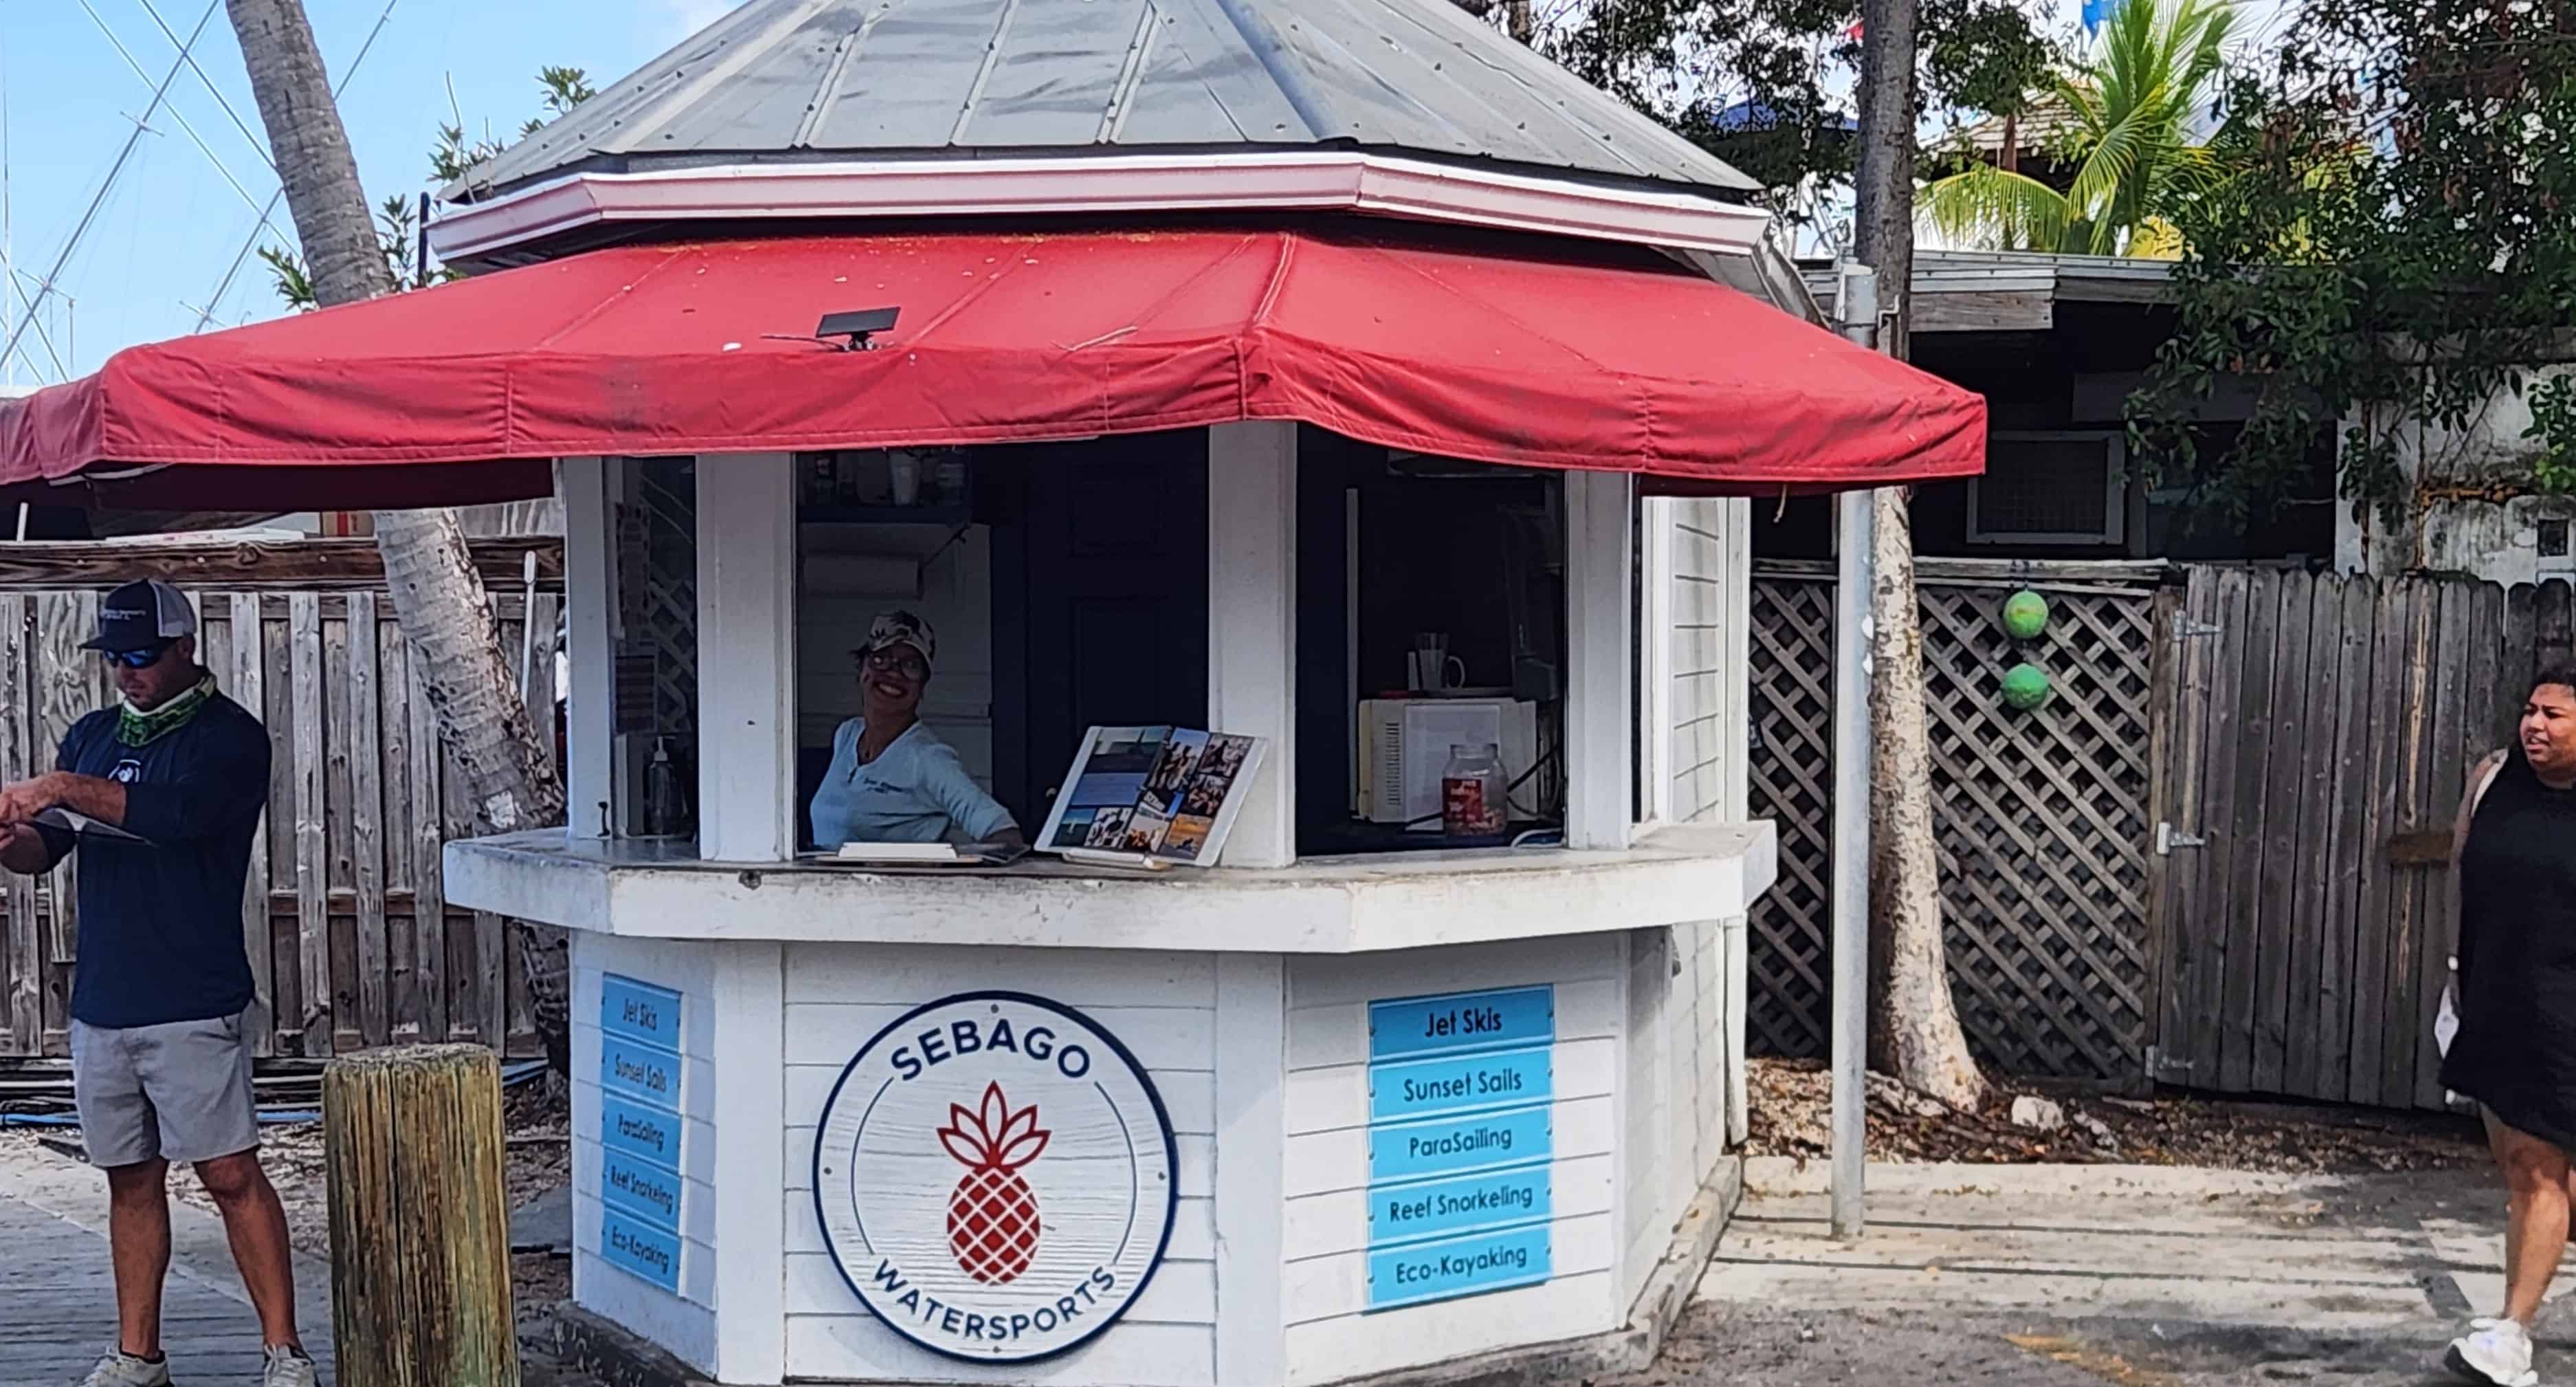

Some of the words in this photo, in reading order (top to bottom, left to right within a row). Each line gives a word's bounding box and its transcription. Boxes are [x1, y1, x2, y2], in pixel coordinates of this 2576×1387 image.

[1425, 1011, 1456, 1037] Jet
[1463, 1007, 1502, 1033] Skis
[891, 1019, 1090, 1080] SEBAGO
[1403, 1074, 1472, 1101] Sunset
[1478, 1069, 1522, 1094] Sails
[1410, 1127, 1512, 1159] ParaSailing
[1390, 1198, 1432, 1222] Reef
[1438, 1185, 1533, 1215] Snorkeling
[1396, 1245, 1527, 1284] Eco-Kayaking
[874, 1258, 1115, 1340] WATERSPORTS
